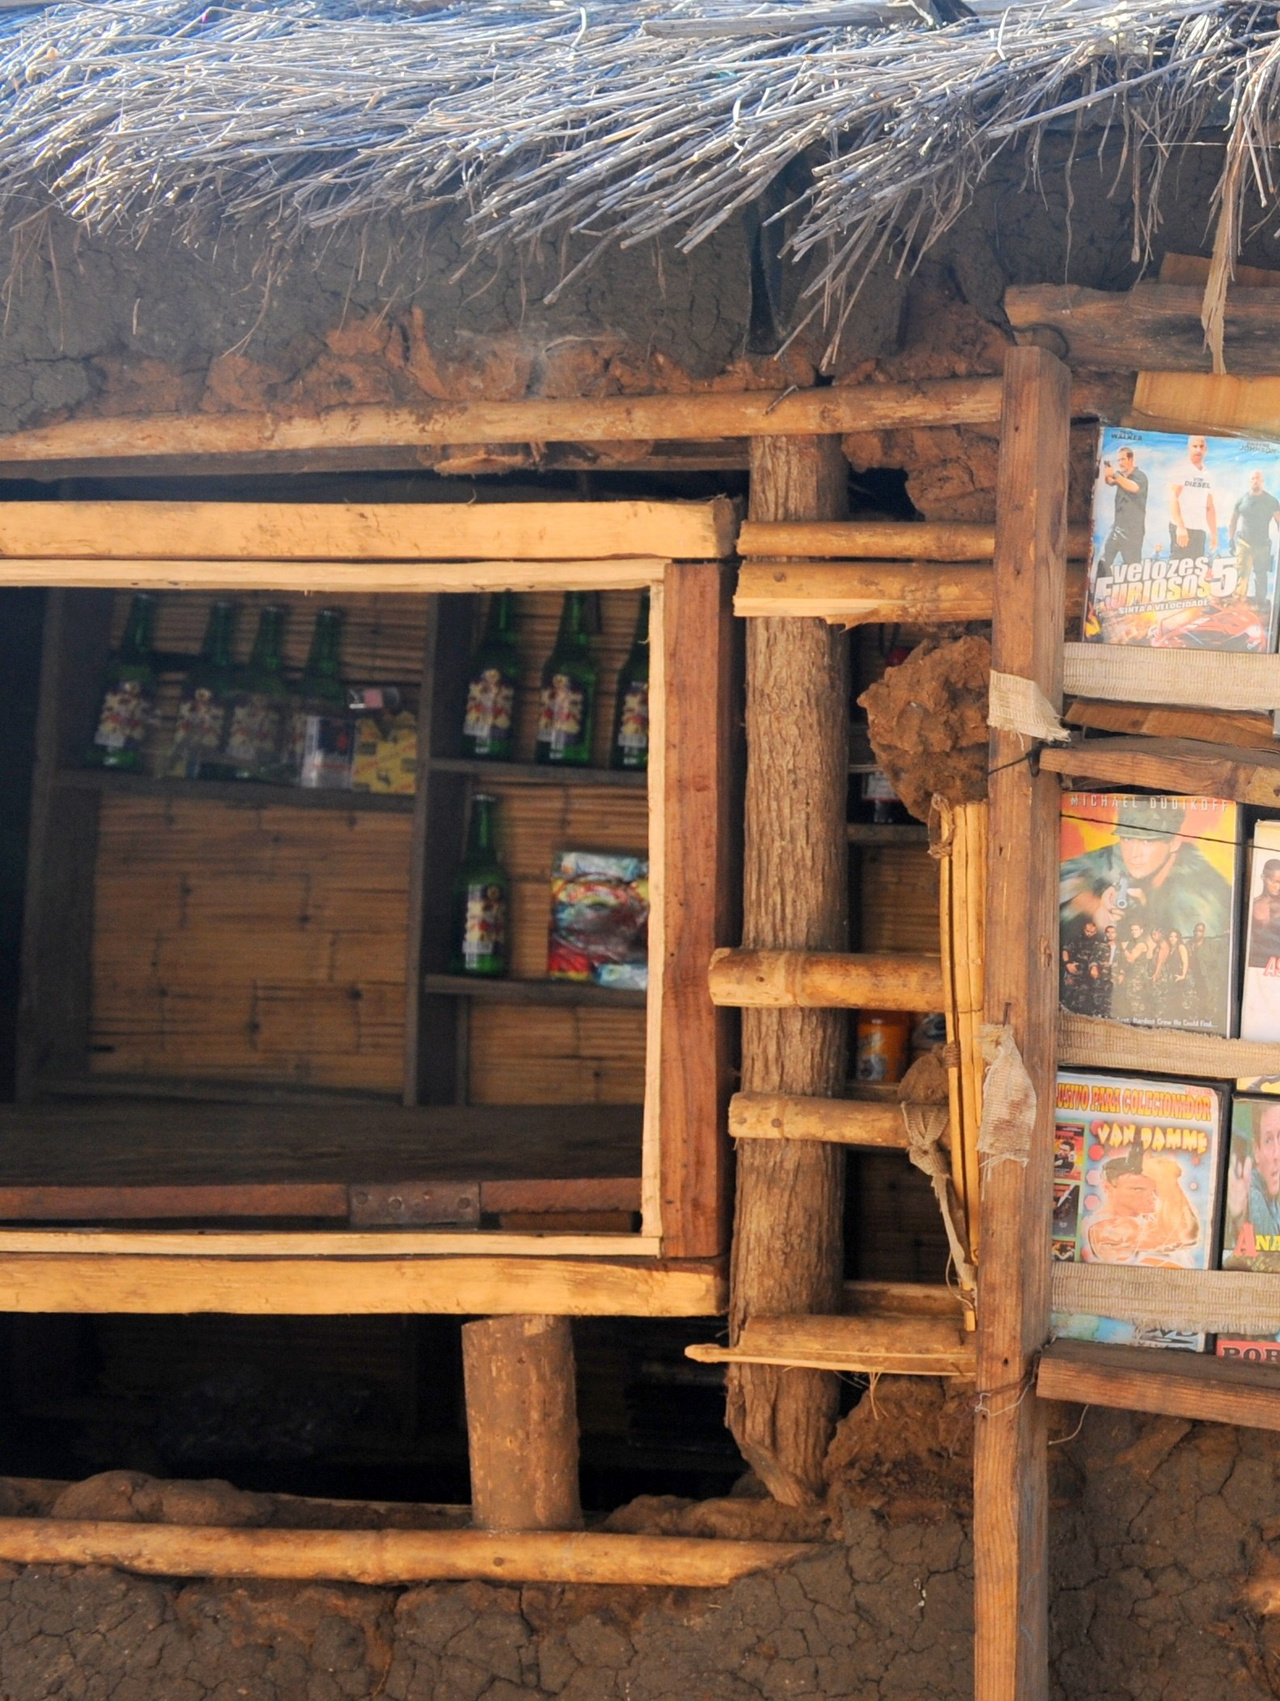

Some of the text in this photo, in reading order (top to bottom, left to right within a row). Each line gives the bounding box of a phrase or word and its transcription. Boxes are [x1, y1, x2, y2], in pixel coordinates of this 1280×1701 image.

[1184, 481, 1211, 489] DIESEL
[1094, 574, 1211, 609] FURIOSOS
[1209, 556, 1238, 598] 5
[1070, 795, 1228, 811] MICHAEL DUDIKOFF
[1056, 1082, 1090, 1111] USIVO
[1090, 1085, 1122, 1113] PARA
[1098, 1122, 1137, 1148] VAN
[1140, 1126, 1209, 1154] DAMME
